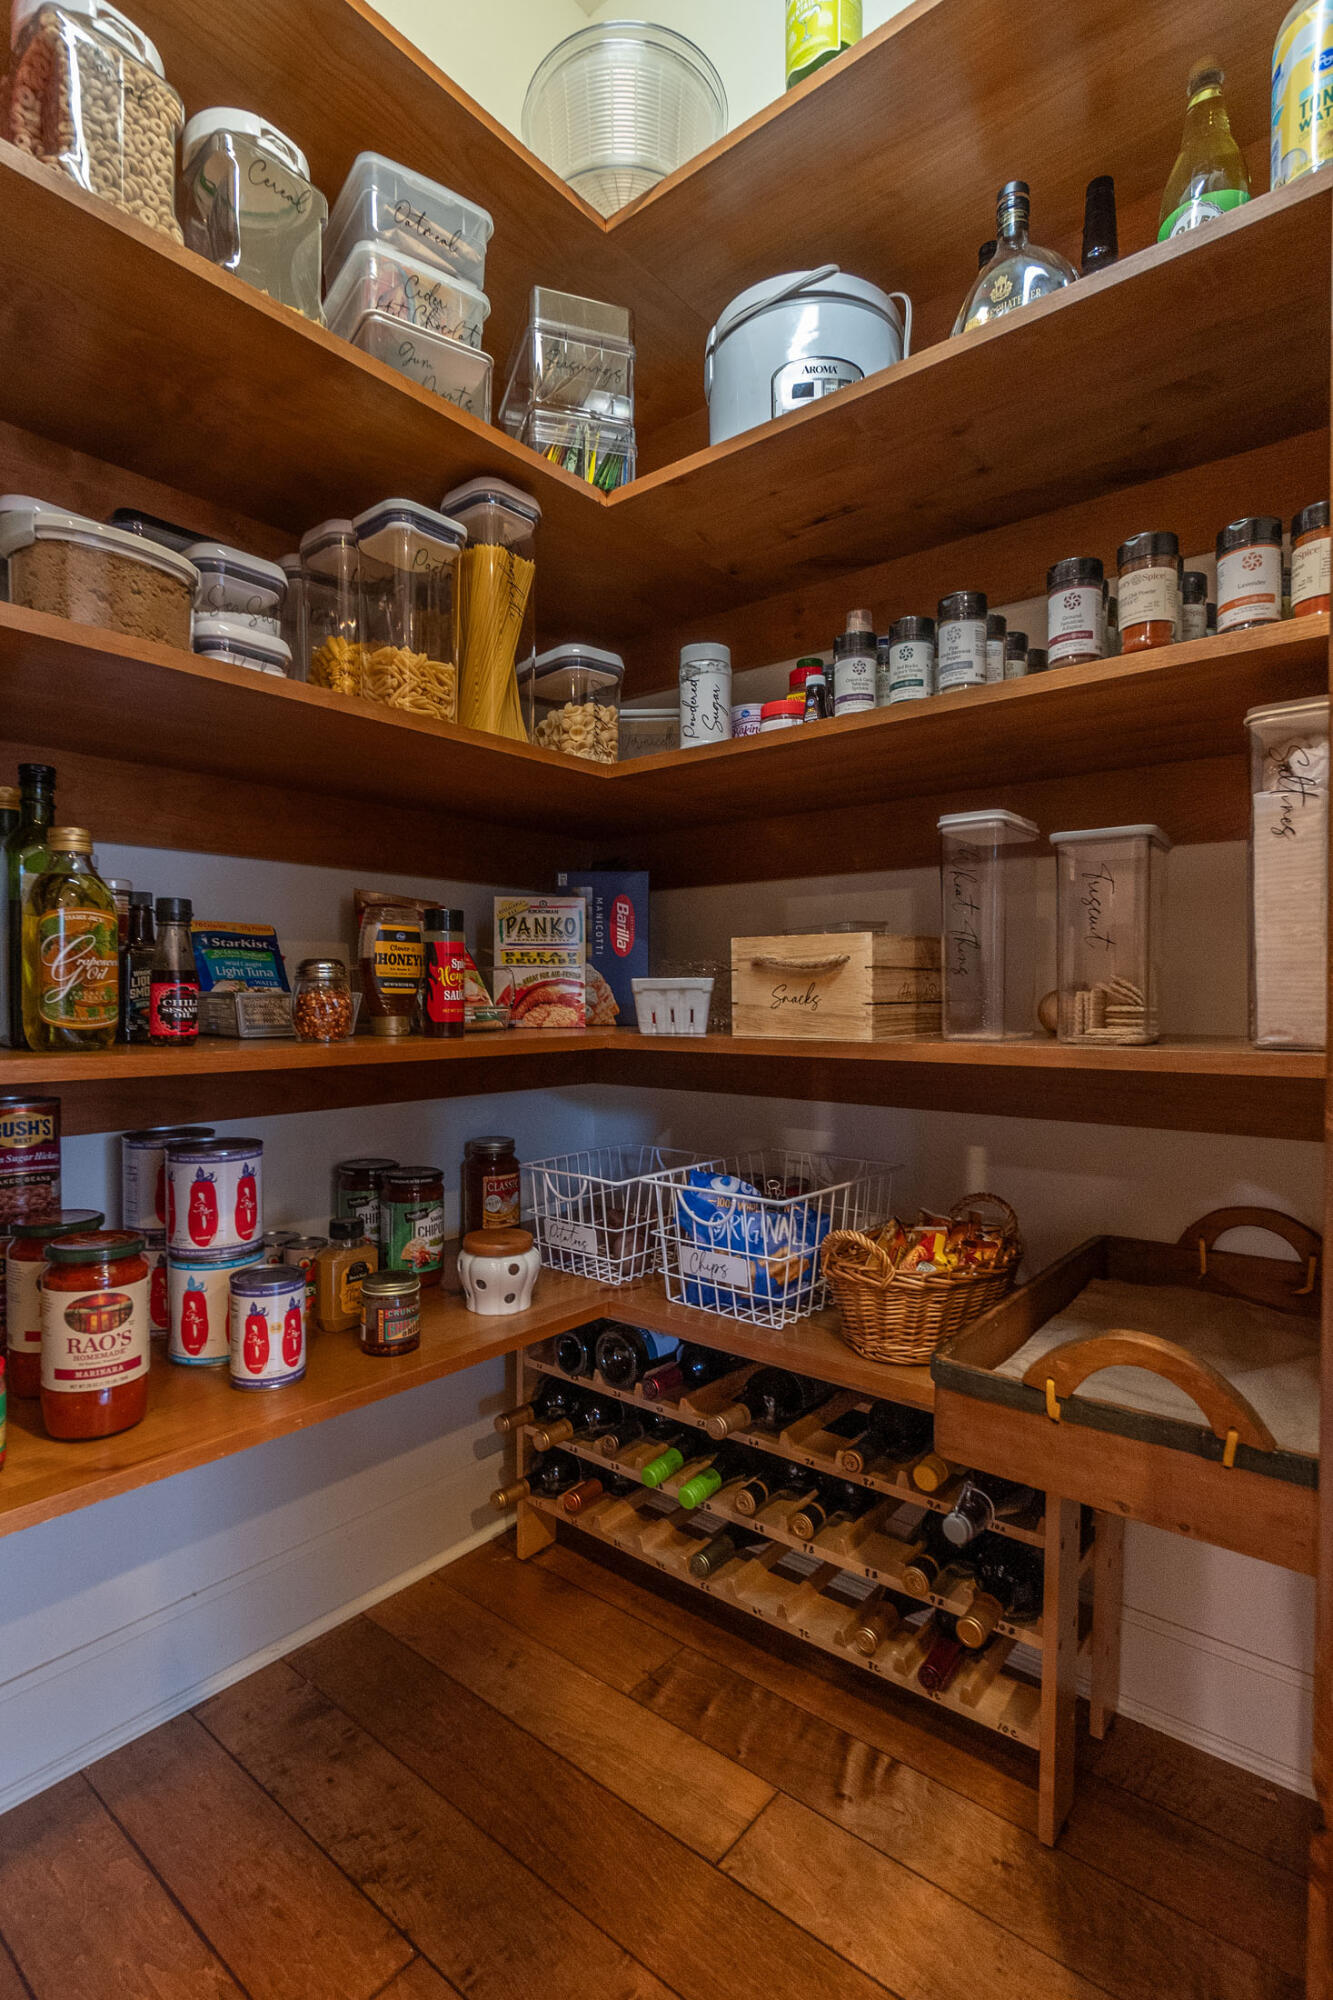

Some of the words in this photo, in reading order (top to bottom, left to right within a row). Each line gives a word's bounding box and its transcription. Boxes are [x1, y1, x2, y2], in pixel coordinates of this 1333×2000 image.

[1300, 86, 1333, 119] TON
[1300, 105, 1333, 132] WAT
[248, 159, 311, 214] Cereal
[394, 200, 464, 254] Oatmeal
[404, 275, 447, 310] Cider
[414, 304, 482, 349] Chocolate
[398, 342, 433, 369] Gum
[802, 364, 837, 374] AROMA
[1237, 580, 1266, 590] Lavender
[682, 671, 700, 739] Powdered
[701, 681, 729, 733] Sugar
[1269, 744, 1319, 840] Saltines
[505, 916, 577, 938] PANKO
[596, 897, 604, 955] MANICOTTI
[616, 902, 630, 950] Barilla
[211, 938, 268, 950] StarKist
[951, 921, 981, 976] Thins
[86, 966, 109, 981] Oil
[215, 966, 245, 979] Light
[247, 967, 275, 978] Tuna
[377, 953, 421, 967] HONEY
[129, 987, 151, 999] SMO
[770, 982, 823, 1011] Snacks
[6, 1153, 33, 1164] Sugar
[690, 1251, 729, 1279] Chips
[67, 1329, 132, 1355] RAO'S
[73, 1348, 126, 1362] HOMEMADE
[74, 1364, 125, 1379] MARINARA
